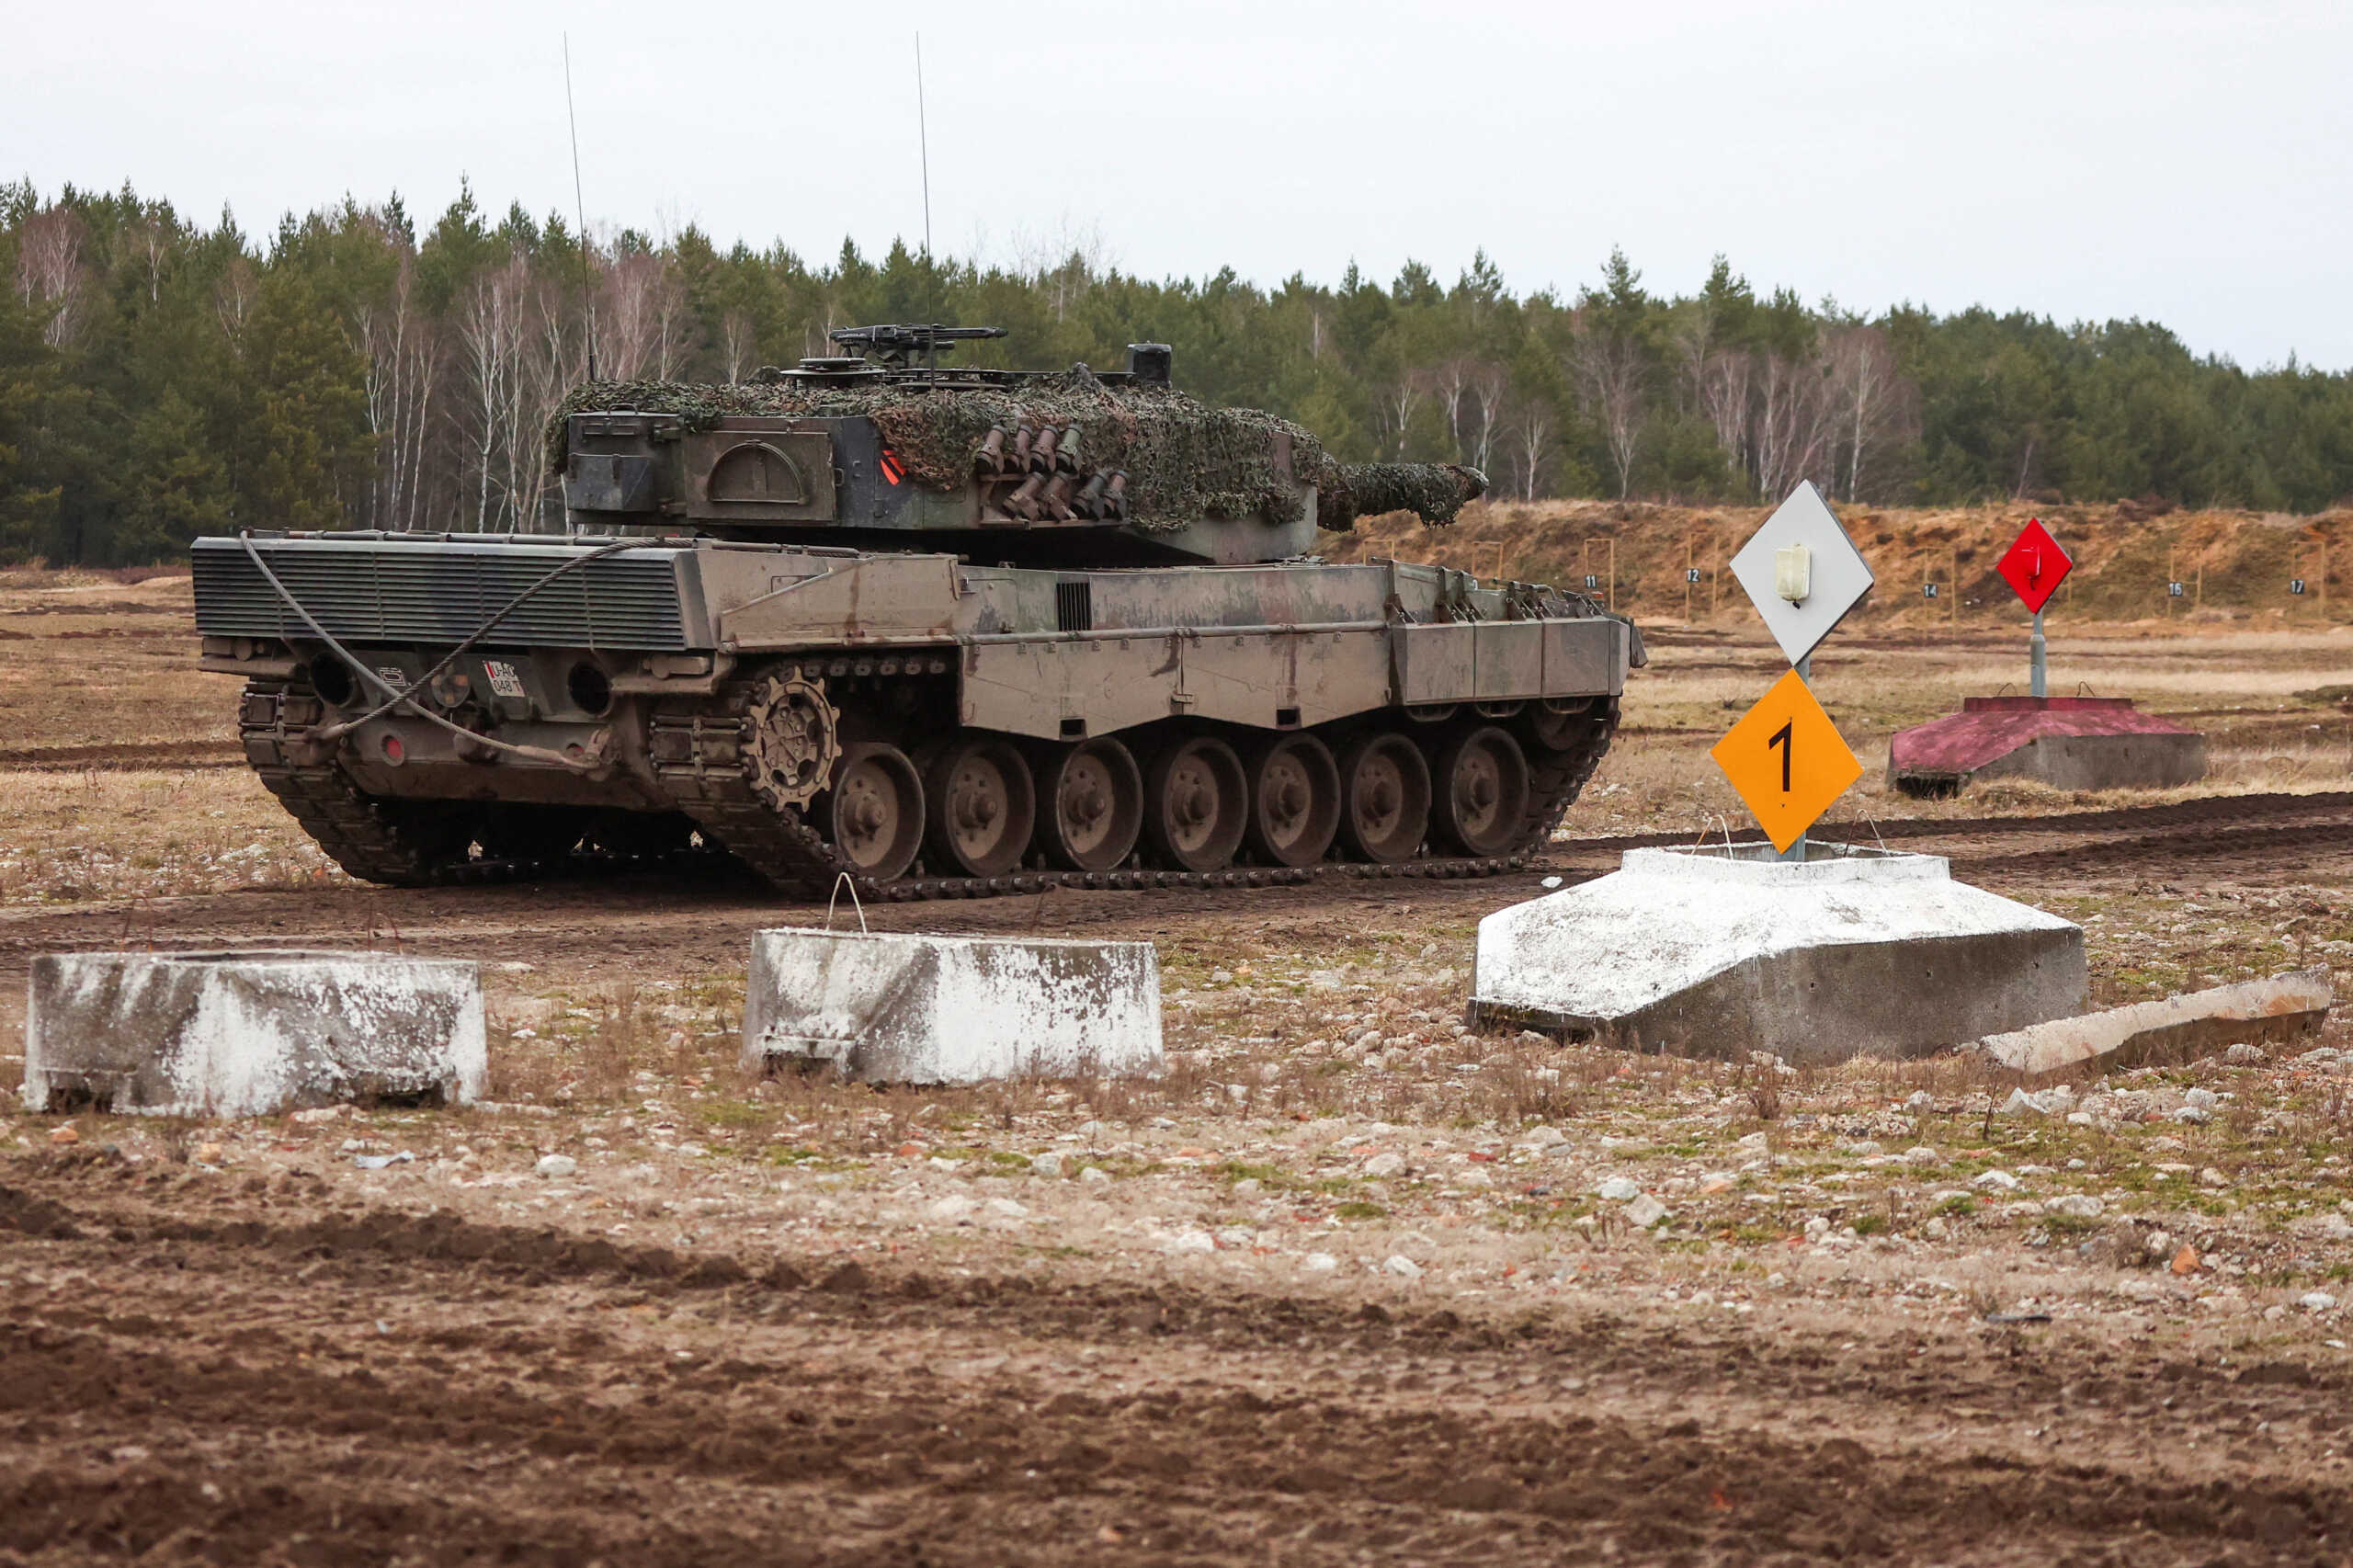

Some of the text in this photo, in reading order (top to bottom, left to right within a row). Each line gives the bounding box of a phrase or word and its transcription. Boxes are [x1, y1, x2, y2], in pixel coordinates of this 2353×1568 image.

[1586, 575, 1596, 587] 11
[1688, 569, 1699, 581] 12
[1924, 585, 1937, 597] 14
[2290, 580, 2303, 593] 17
[1768, 721, 1792, 792] 1
